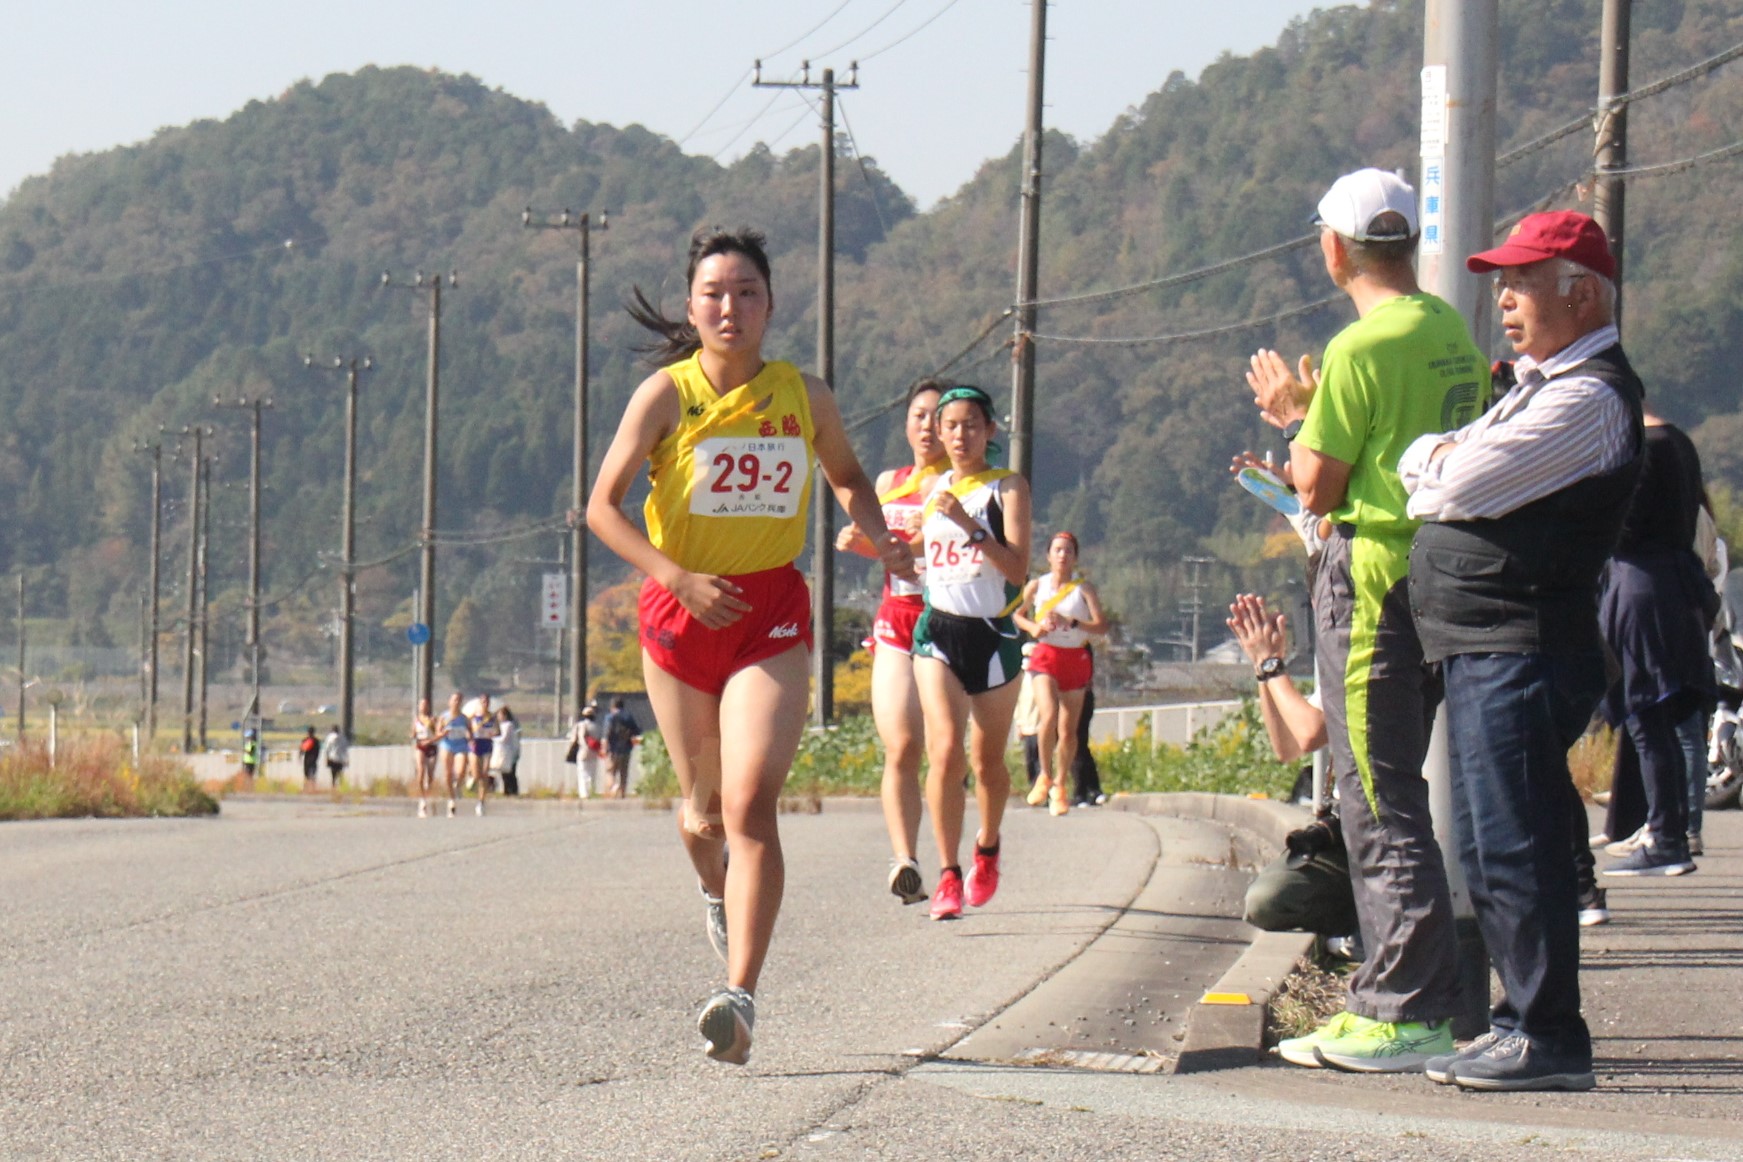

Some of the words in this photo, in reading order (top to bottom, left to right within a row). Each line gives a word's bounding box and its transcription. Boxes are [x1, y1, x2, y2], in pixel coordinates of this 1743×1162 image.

[1424, 166, 1440, 245] 兵庫県
[748, 443, 785, 451] 日本旅行
[711, 453, 793, 493] 29-2
[930, 540, 983, 567] 26-2
